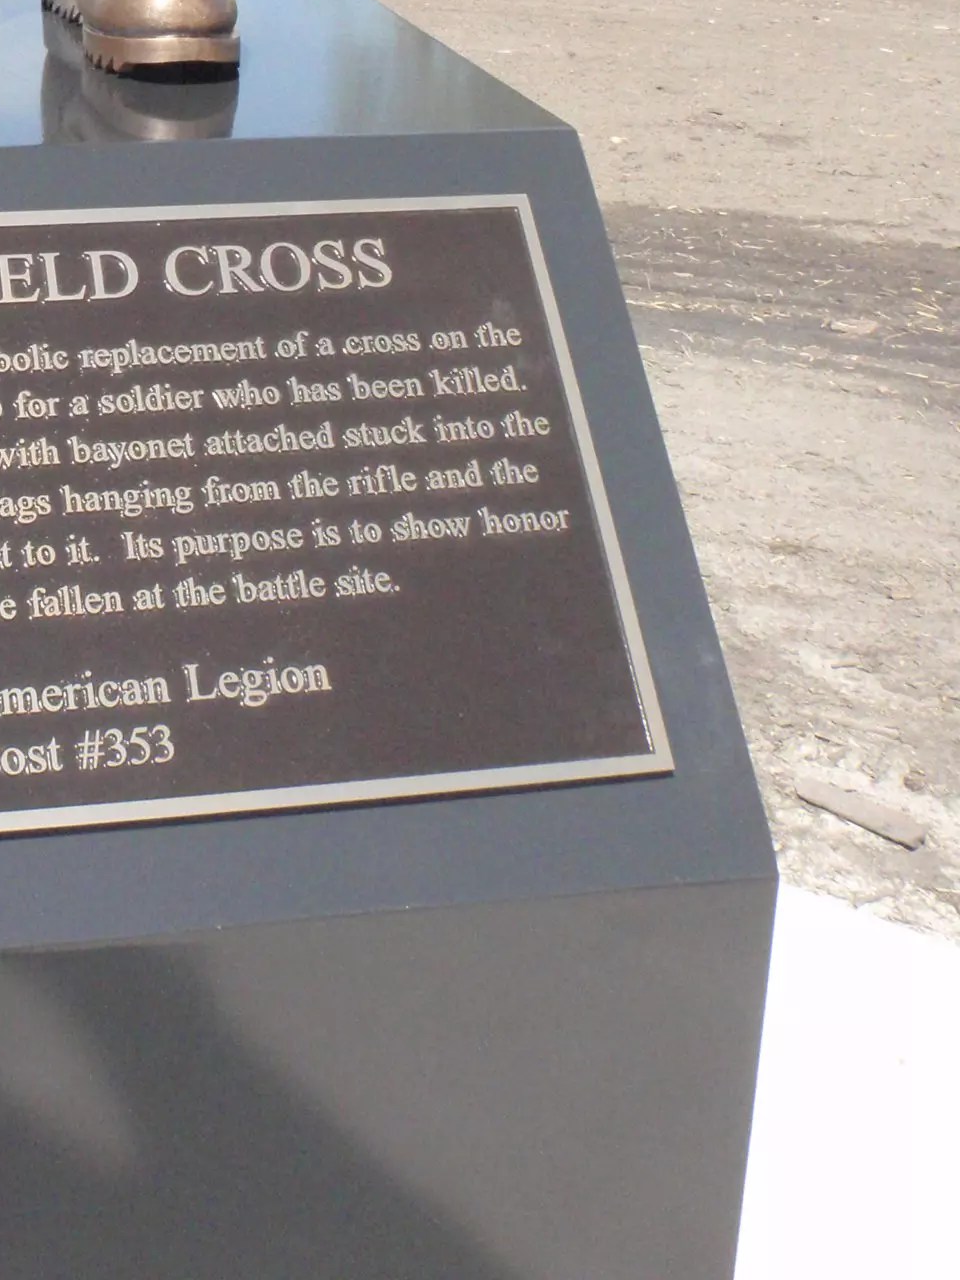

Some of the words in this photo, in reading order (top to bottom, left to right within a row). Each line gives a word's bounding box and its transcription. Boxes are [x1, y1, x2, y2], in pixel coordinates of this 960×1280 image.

[163, 238, 392, 295] CROSS
[79, 338, 267, 374] replacement
[274, 331, 309, 359] of
[315, 337, 335, 356] a
[342, 333, 421, 355] cross
[429, 331, 468, 349] on
[479, 323, 522, 346] the
[13, 390, 60, 421] for
[69, 395, 89, 417] a
[97, 383, 204, 414] soldier
[212, 379, 281, 409] who
[286, 376, 342, 405] has
[346, 373, 424, 399] been
[428, 365, 527, 397] killed.
[67, 433, 195, 468] bayonet
[204, 421, 335, 456] attached
[342, 416, 427, 448] stuck
[436, 415, 495, 443] into
[500, 410, 550, 438] the
[59, 480, 194, 518] hanging
[201, 476, 281, 507] from
[287, 470, 339, 500] the
[346, 465, 417, 496] rifle
[425, 459, 484, 490] and
[489, 457, 539, 485] the
[21, 541, 56, 568] to
[65, 534, 100, 566] it.
[123, 532, 164, 560] Its
[171, 528, 304, 566] purpose
[311, 518, 341, 548] is
[348, 520, 382, 543] to
[390, 512, 471, 541] show
[480, 507, 569, 534] honor
[26, 585, 124, 620] fallen
[132, 583, 165, 610] at
[172, 577, 226, 608] the
[232, 569, 326, 603] battle
[334, 565, 400, 597] site.
[182, 657, 332, 707] Legion
[76, 724, 174, 770] #353
